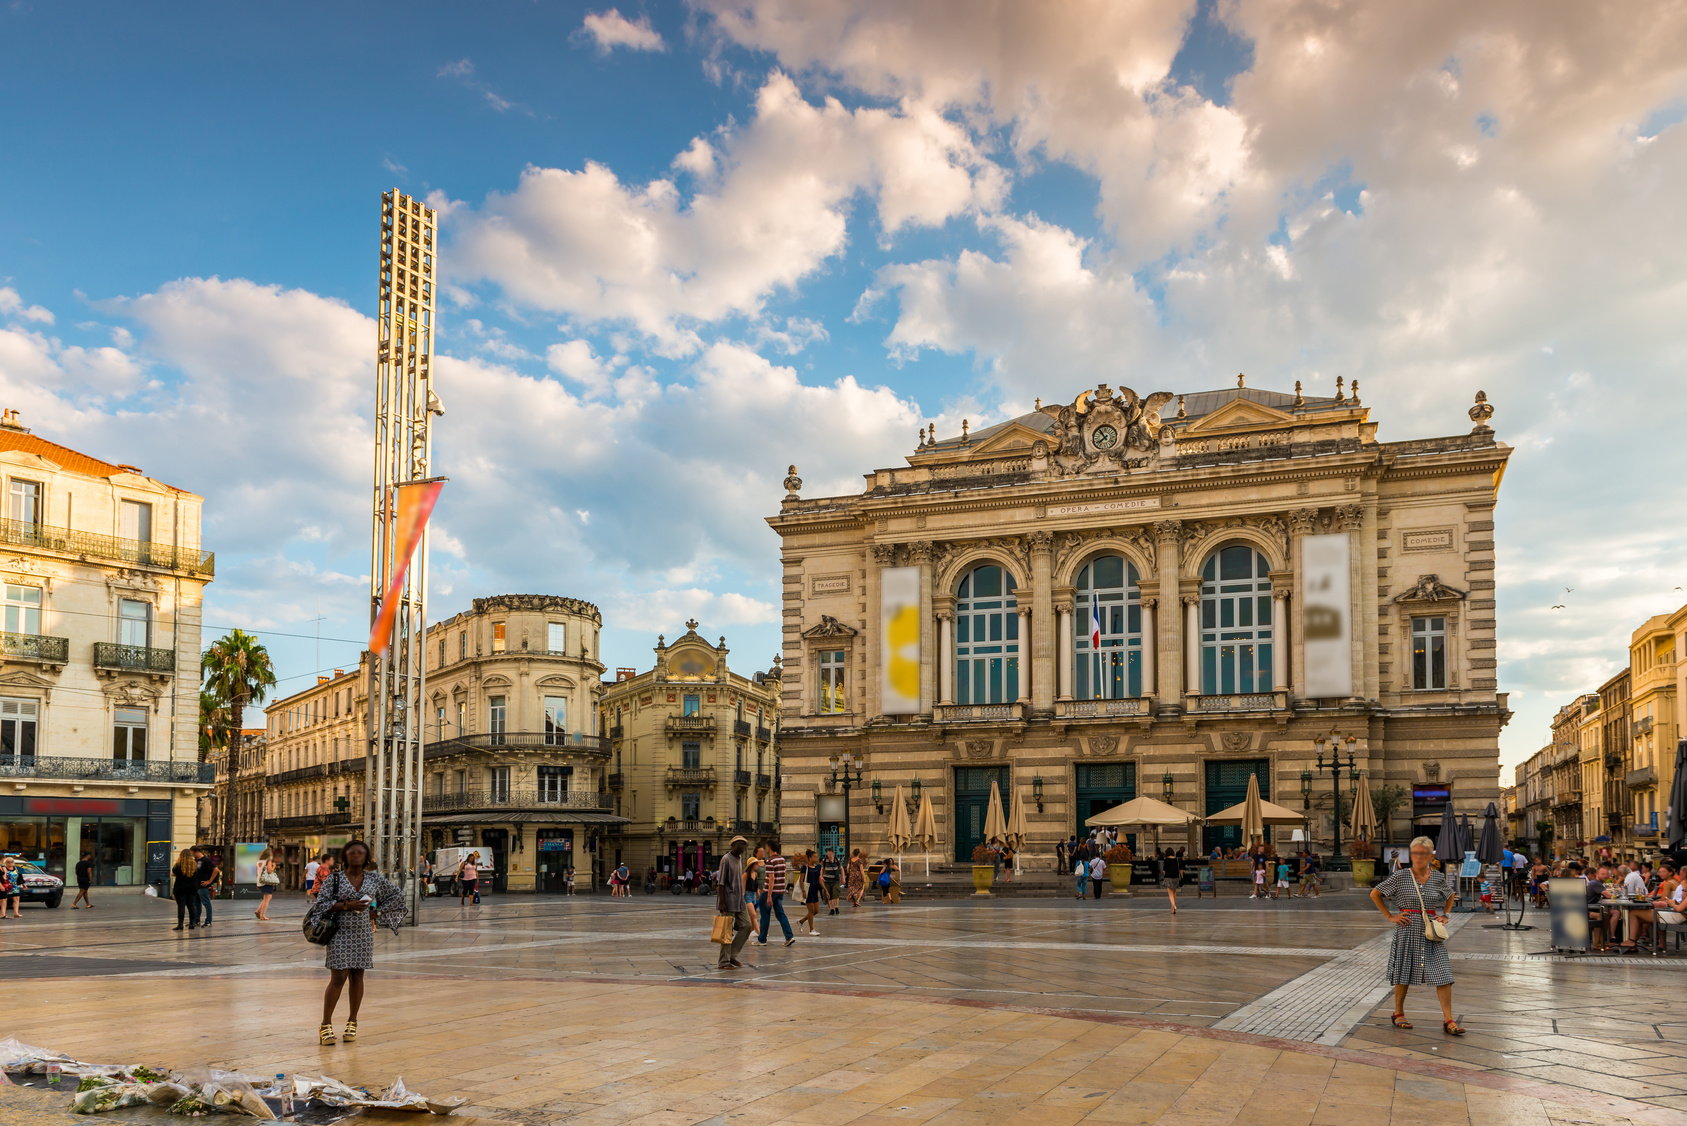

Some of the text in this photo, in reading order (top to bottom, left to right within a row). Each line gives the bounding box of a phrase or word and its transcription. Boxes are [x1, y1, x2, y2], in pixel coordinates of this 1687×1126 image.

[1060, 506, 1090, 514] OPERA
[1104, 500, 1146, 510] COMEDIE
[1410, 536, 1445, 545] COMEDIE
